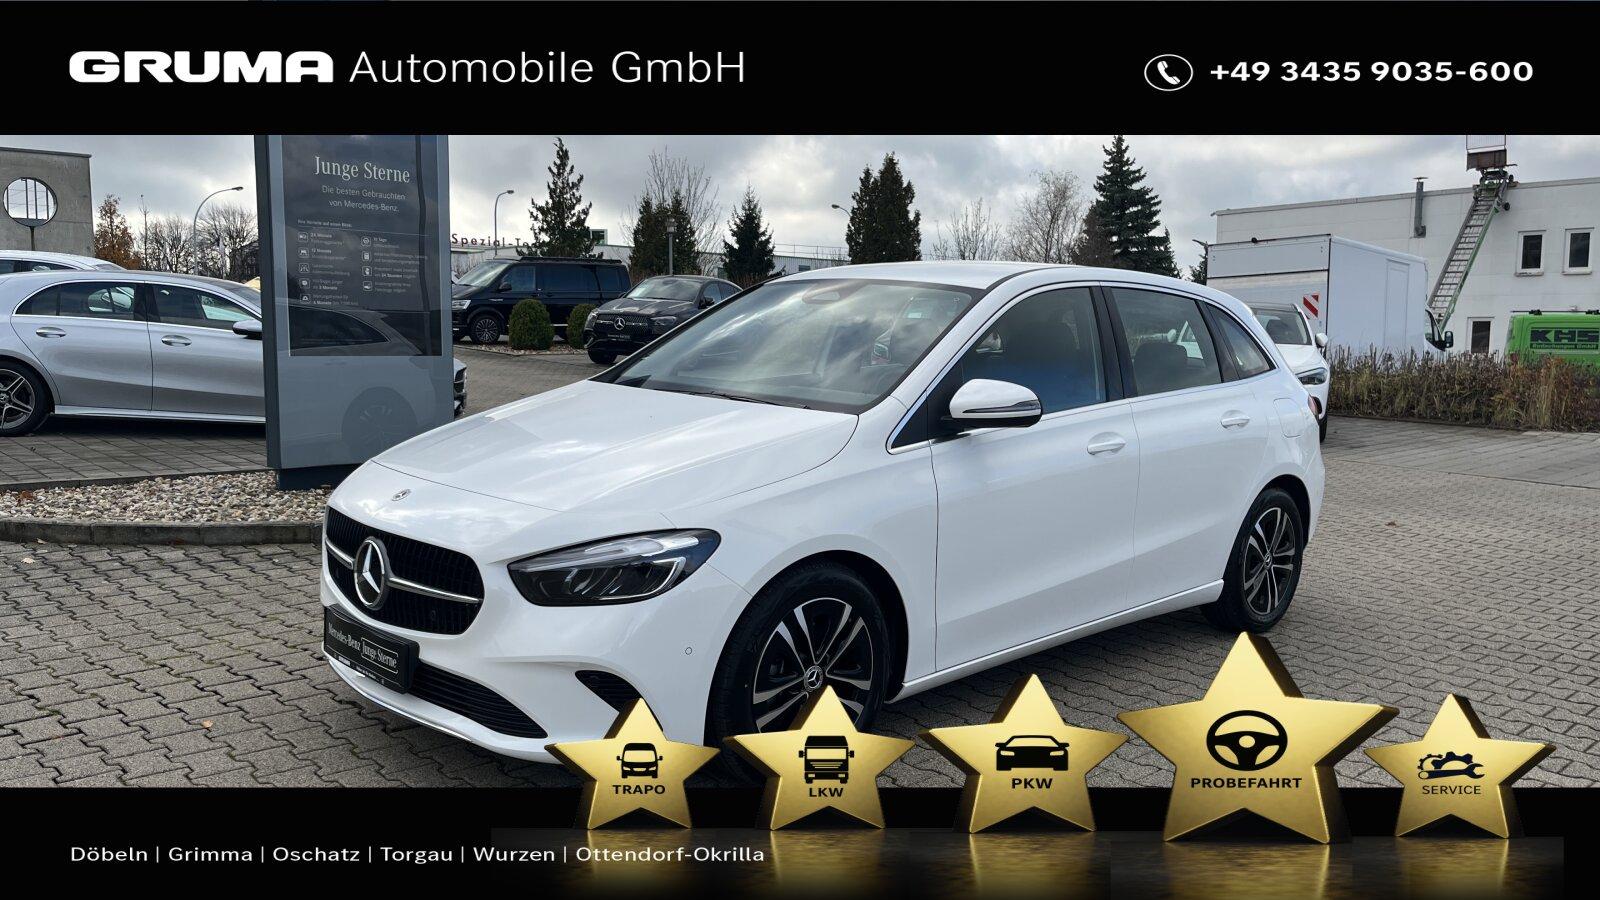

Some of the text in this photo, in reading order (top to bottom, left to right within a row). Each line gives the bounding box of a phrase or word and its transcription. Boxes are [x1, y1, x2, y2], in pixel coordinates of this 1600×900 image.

[314, 155, 410, 183] Junge Sterne
[322, 184, 406, 201] Die besten Gebrauchten
[329, 199, 343, 207] von
[1531, 329, 1599, 343] KHS
[328, 622, 361, 651] Mercedes-Benz
[362, 640, 377, 661] Junge
[377, 648, 398, 668] Sterne
